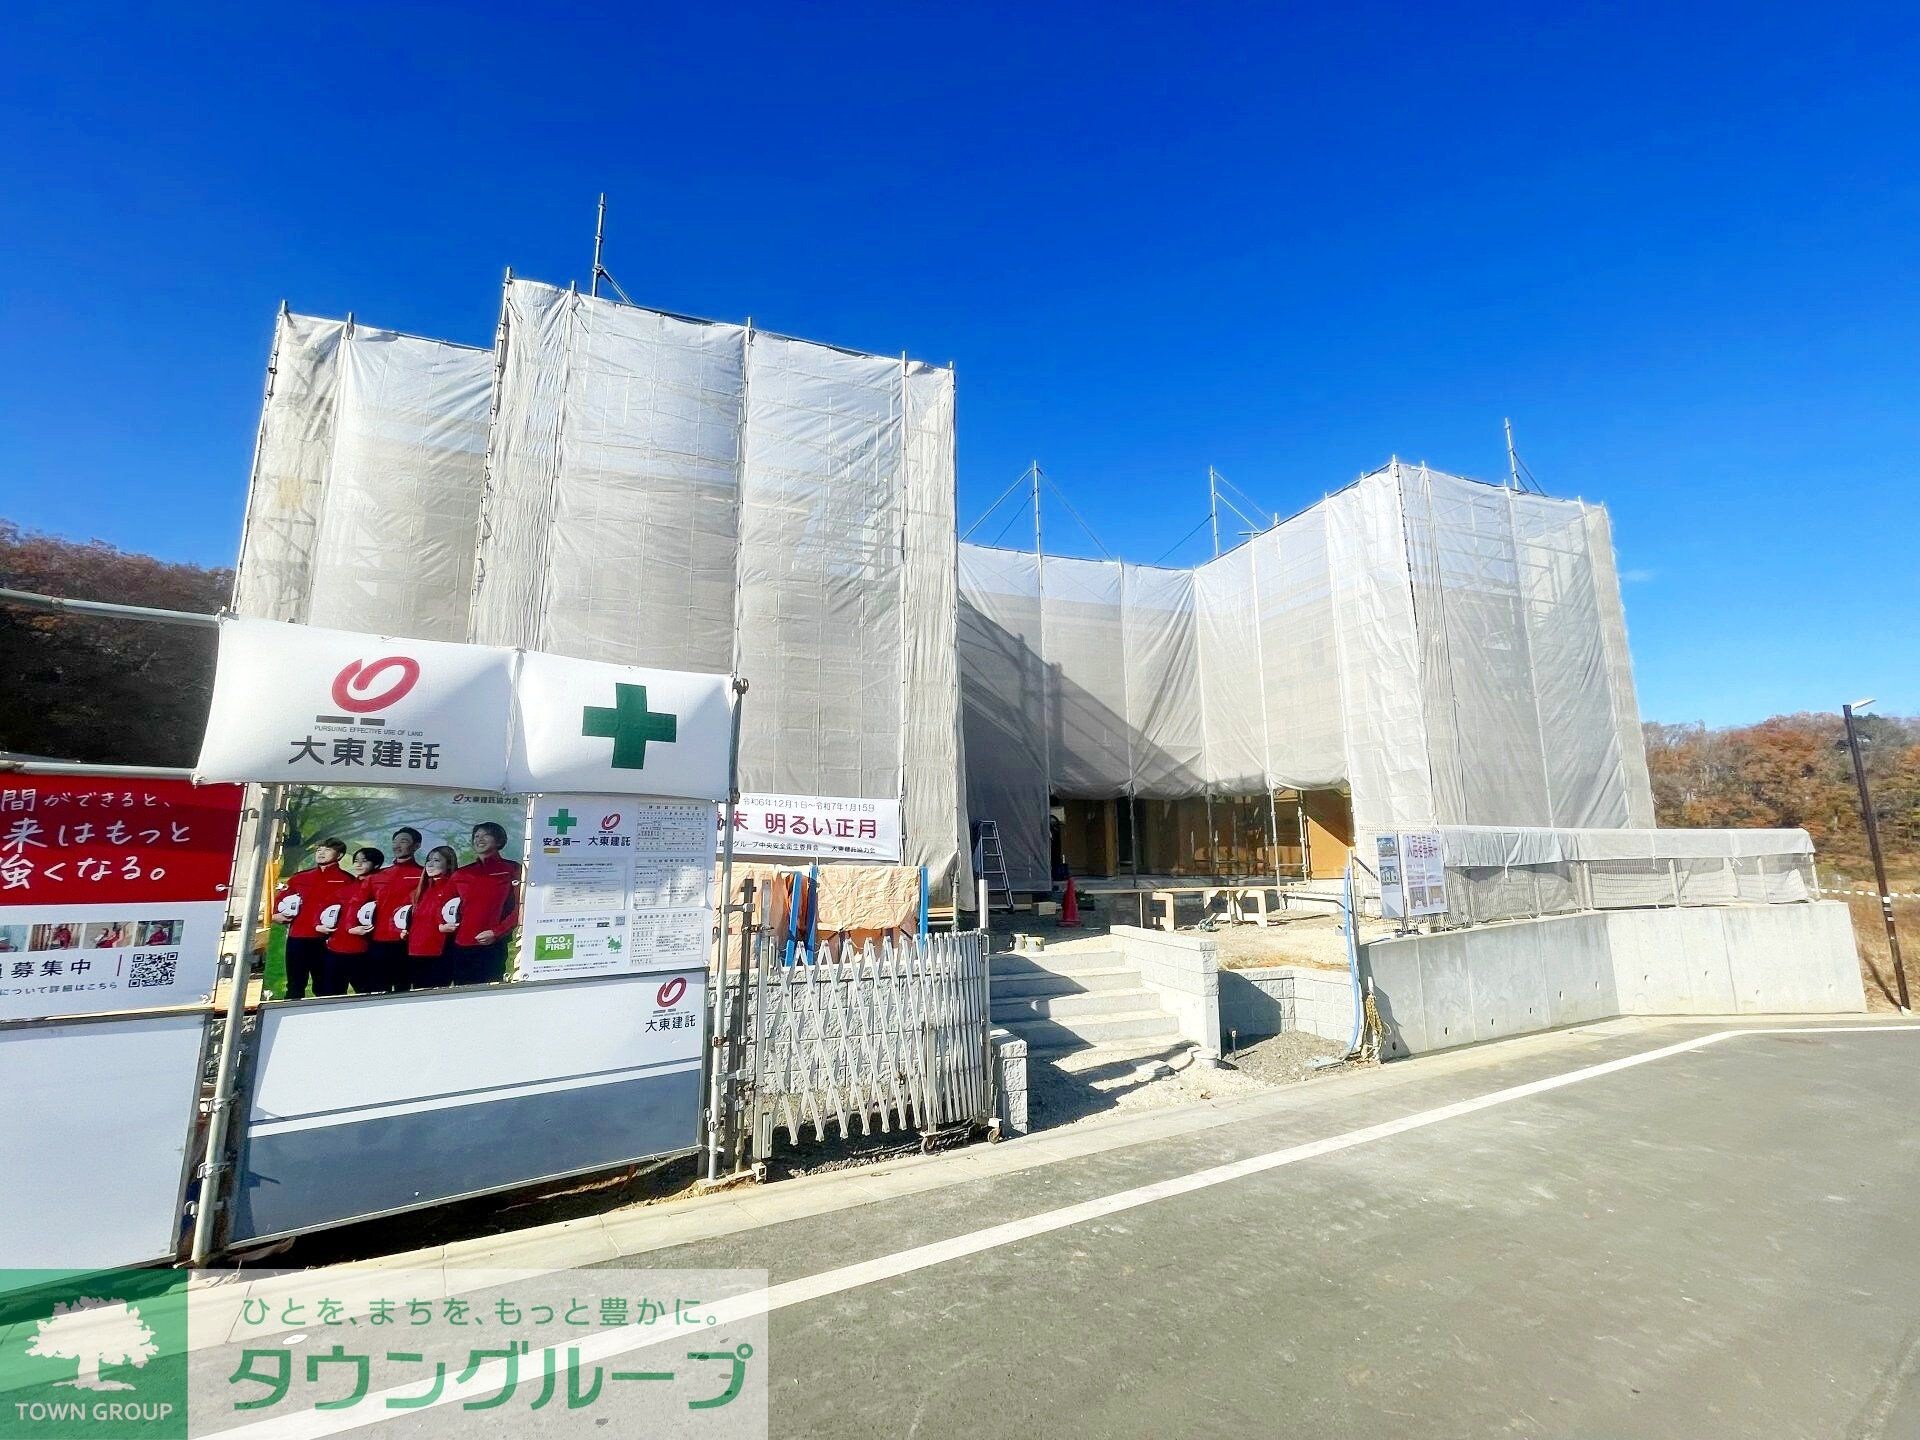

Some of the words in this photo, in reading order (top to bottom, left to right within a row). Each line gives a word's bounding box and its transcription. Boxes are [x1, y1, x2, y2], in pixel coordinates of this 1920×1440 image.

[314, 725, 347, 733] PURSUING
[349, 727, 382, 735] EFFECTIVE
[288, 735, 441, 770] 大東建託
[3, 817, 190, 853] 来はもっと
[765, 812, 877, 839] 明るい正月
[542, 837, 581, 847] 安全第一
[587, 835, 632, 847] 大東建託
[545, 935, 566, 944] ECO
[545, 942, 572, 951] FIRST
[0, 958, 92, 979] 募集中
[644, 1014, 697, 1034] 大東建託
